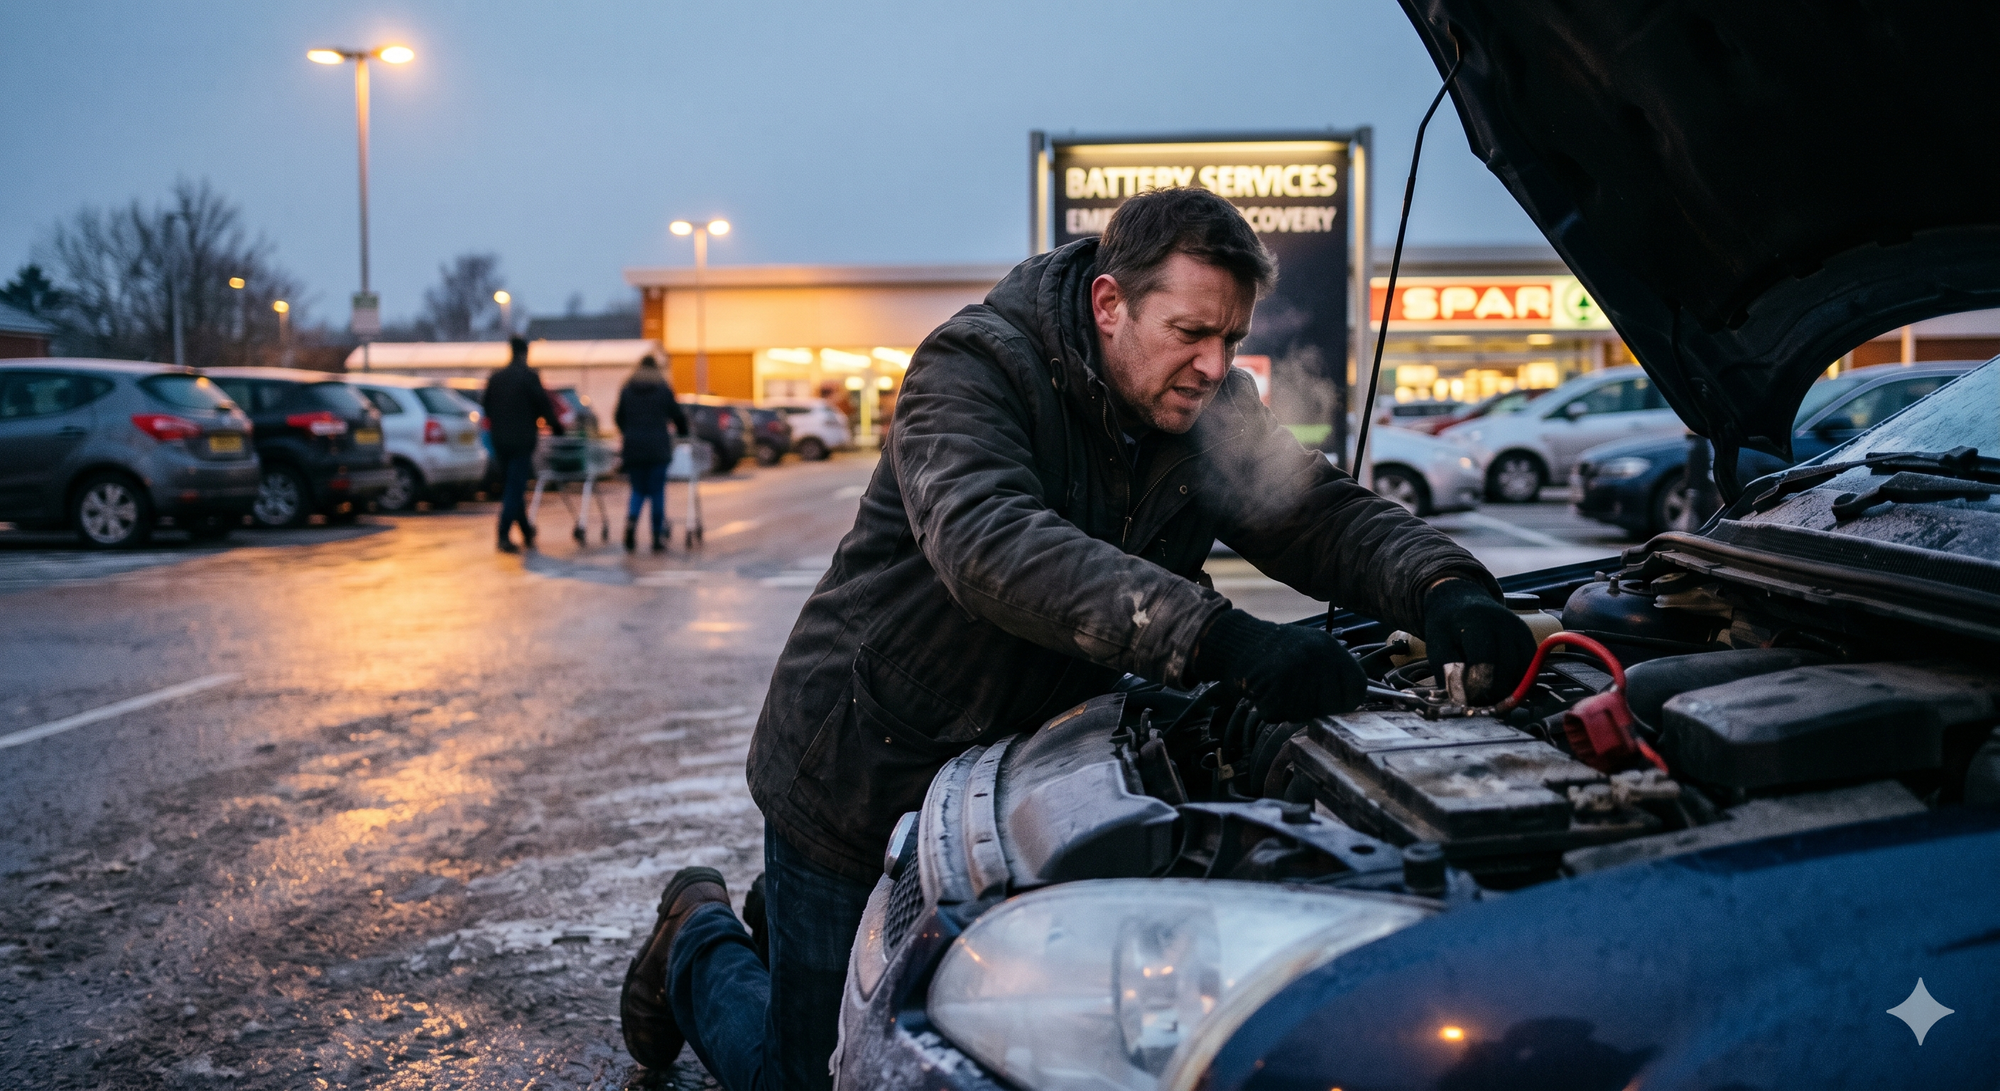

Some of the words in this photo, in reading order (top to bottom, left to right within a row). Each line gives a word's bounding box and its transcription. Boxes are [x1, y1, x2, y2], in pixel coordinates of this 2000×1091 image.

[1066, 166, 1196, 199] BATTERY
[1199, 164, 1337, 198] SERVICES
[1237, 206, 1337, 233] COVERY
[1402, 286, 1551, 320] SPAR
